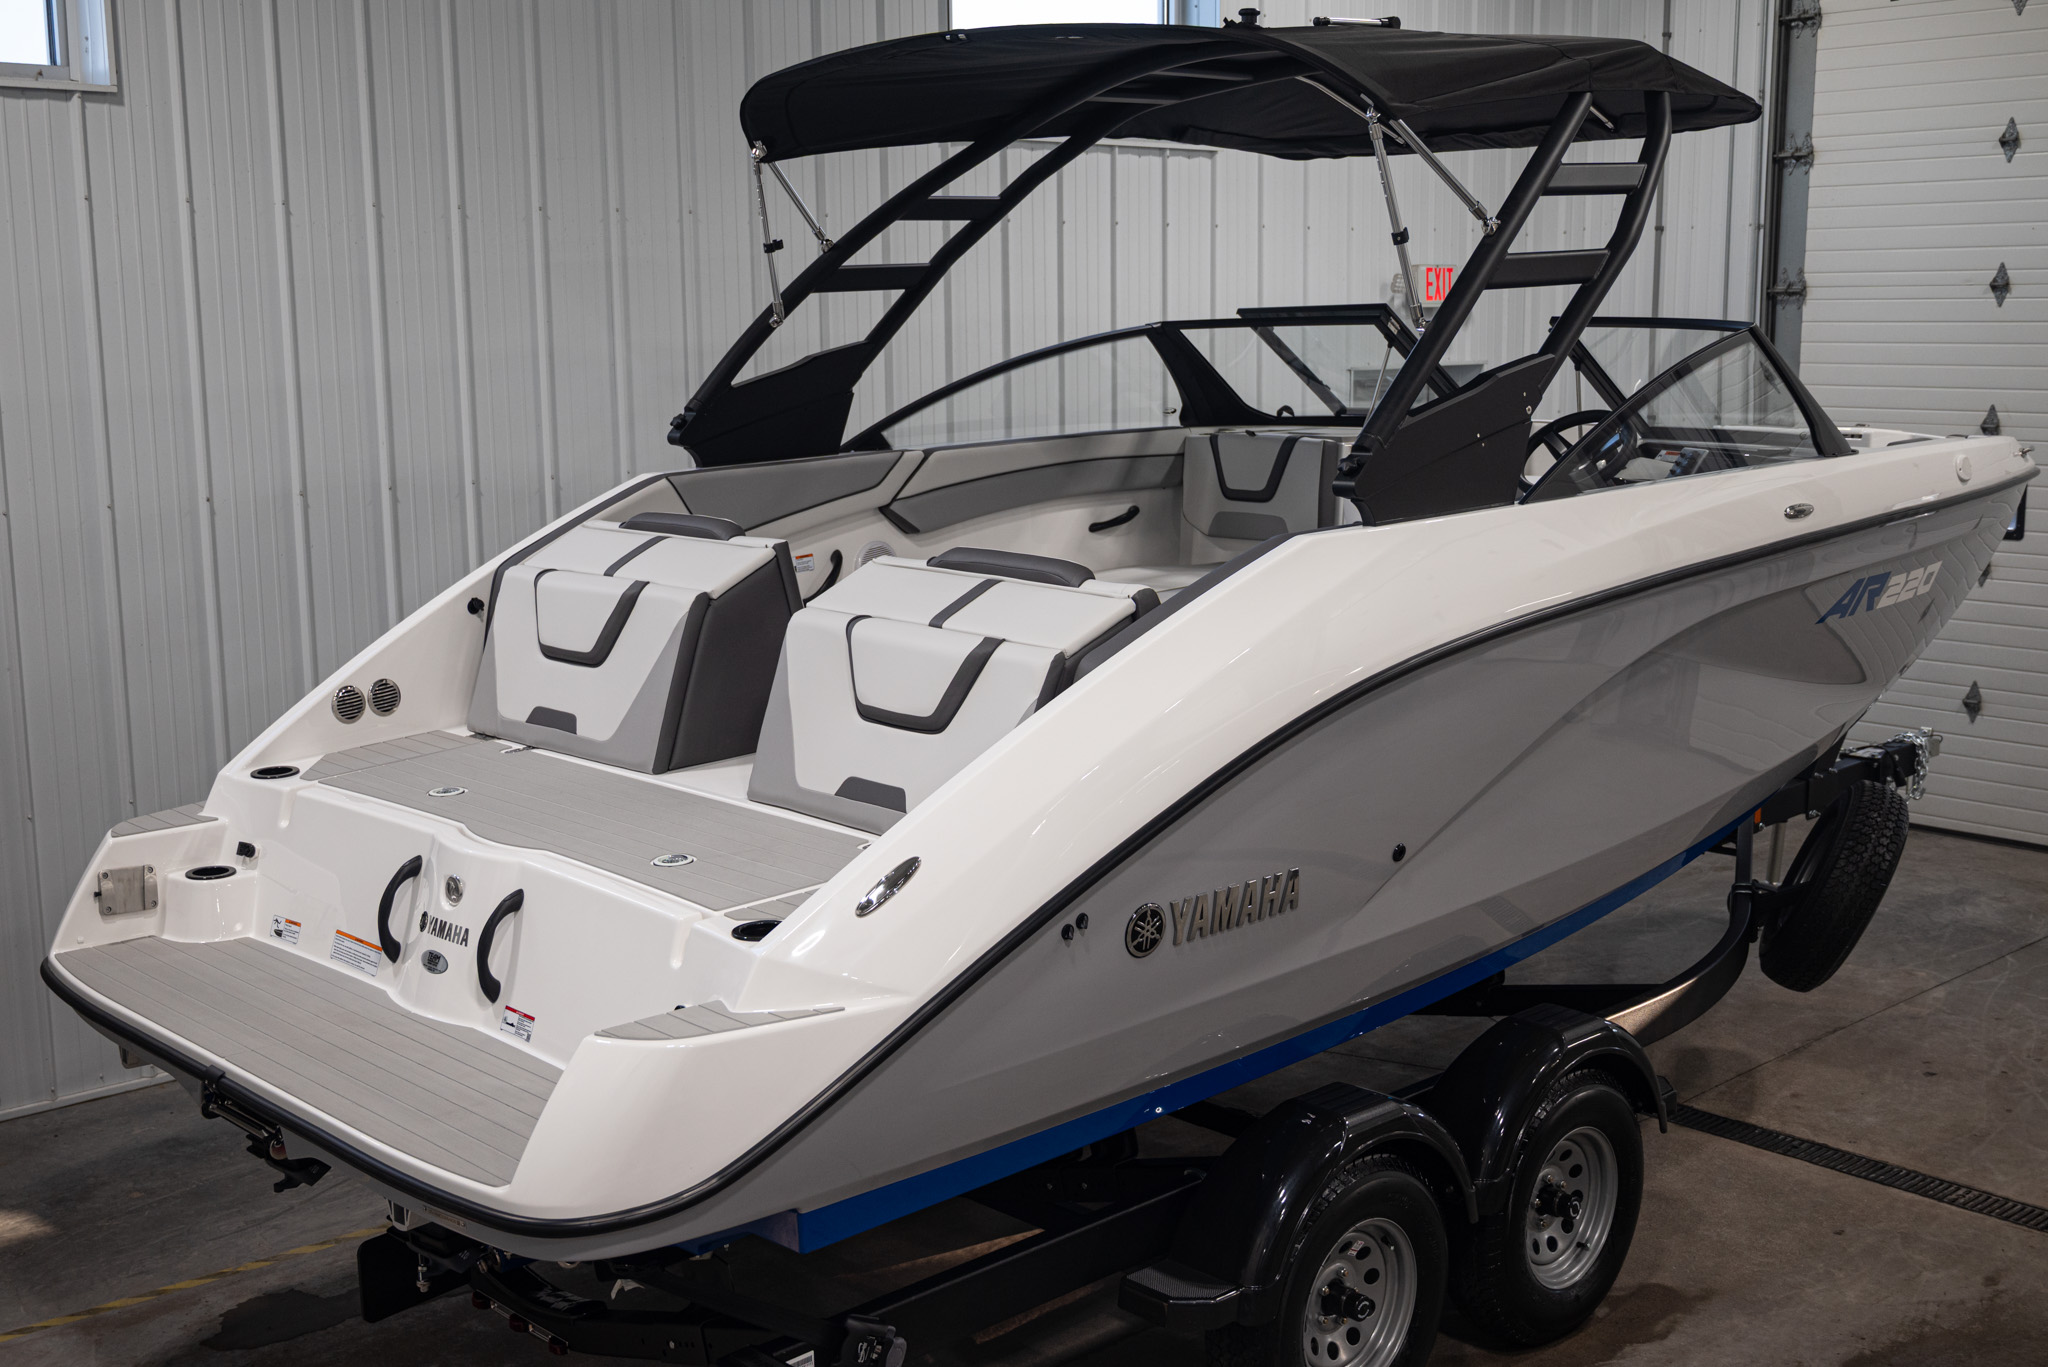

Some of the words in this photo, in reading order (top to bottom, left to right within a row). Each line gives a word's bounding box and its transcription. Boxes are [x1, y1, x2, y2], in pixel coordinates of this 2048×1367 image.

[1426, 267, 1454, 301] EXIT
[1169, 867, 1300, 946] YAMAHA
[427, 914, 470, 947] YAMAHA
